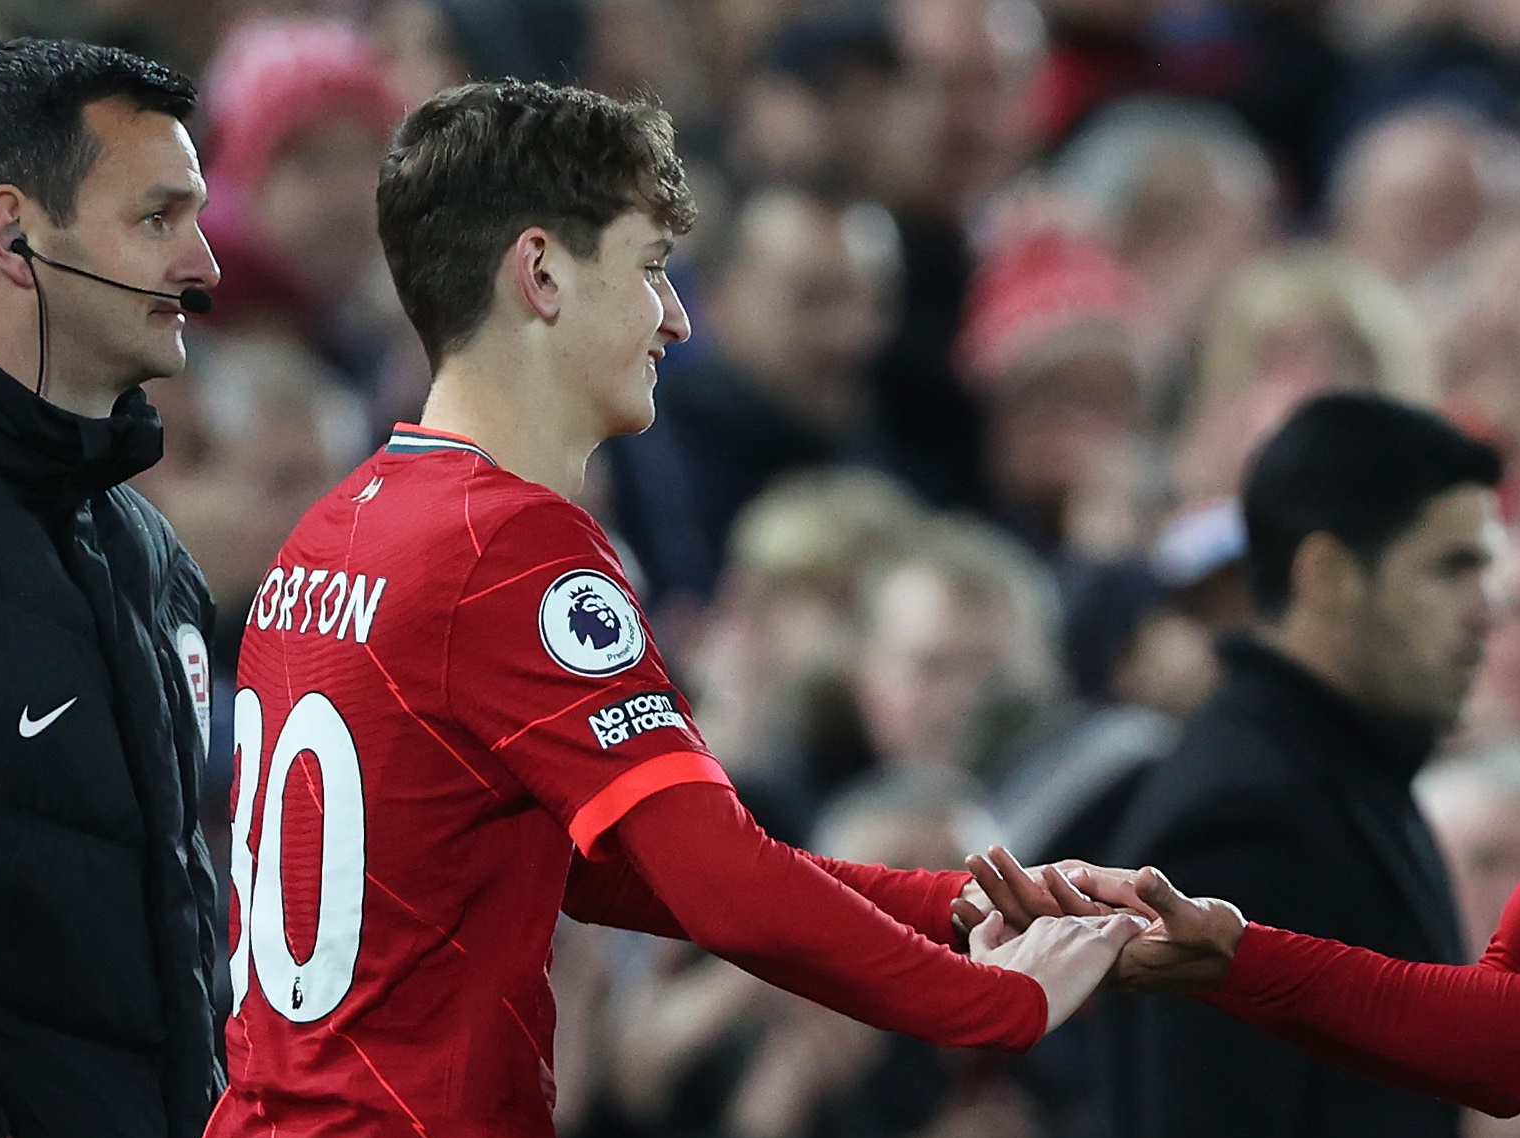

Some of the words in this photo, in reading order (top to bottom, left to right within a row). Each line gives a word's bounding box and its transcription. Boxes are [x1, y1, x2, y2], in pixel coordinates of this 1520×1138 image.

[588, 707, 625, 735] No
[625, 694, 674, 718] room
[596, 720, 630, 750] for
[631, 710, 689, 735] racism
